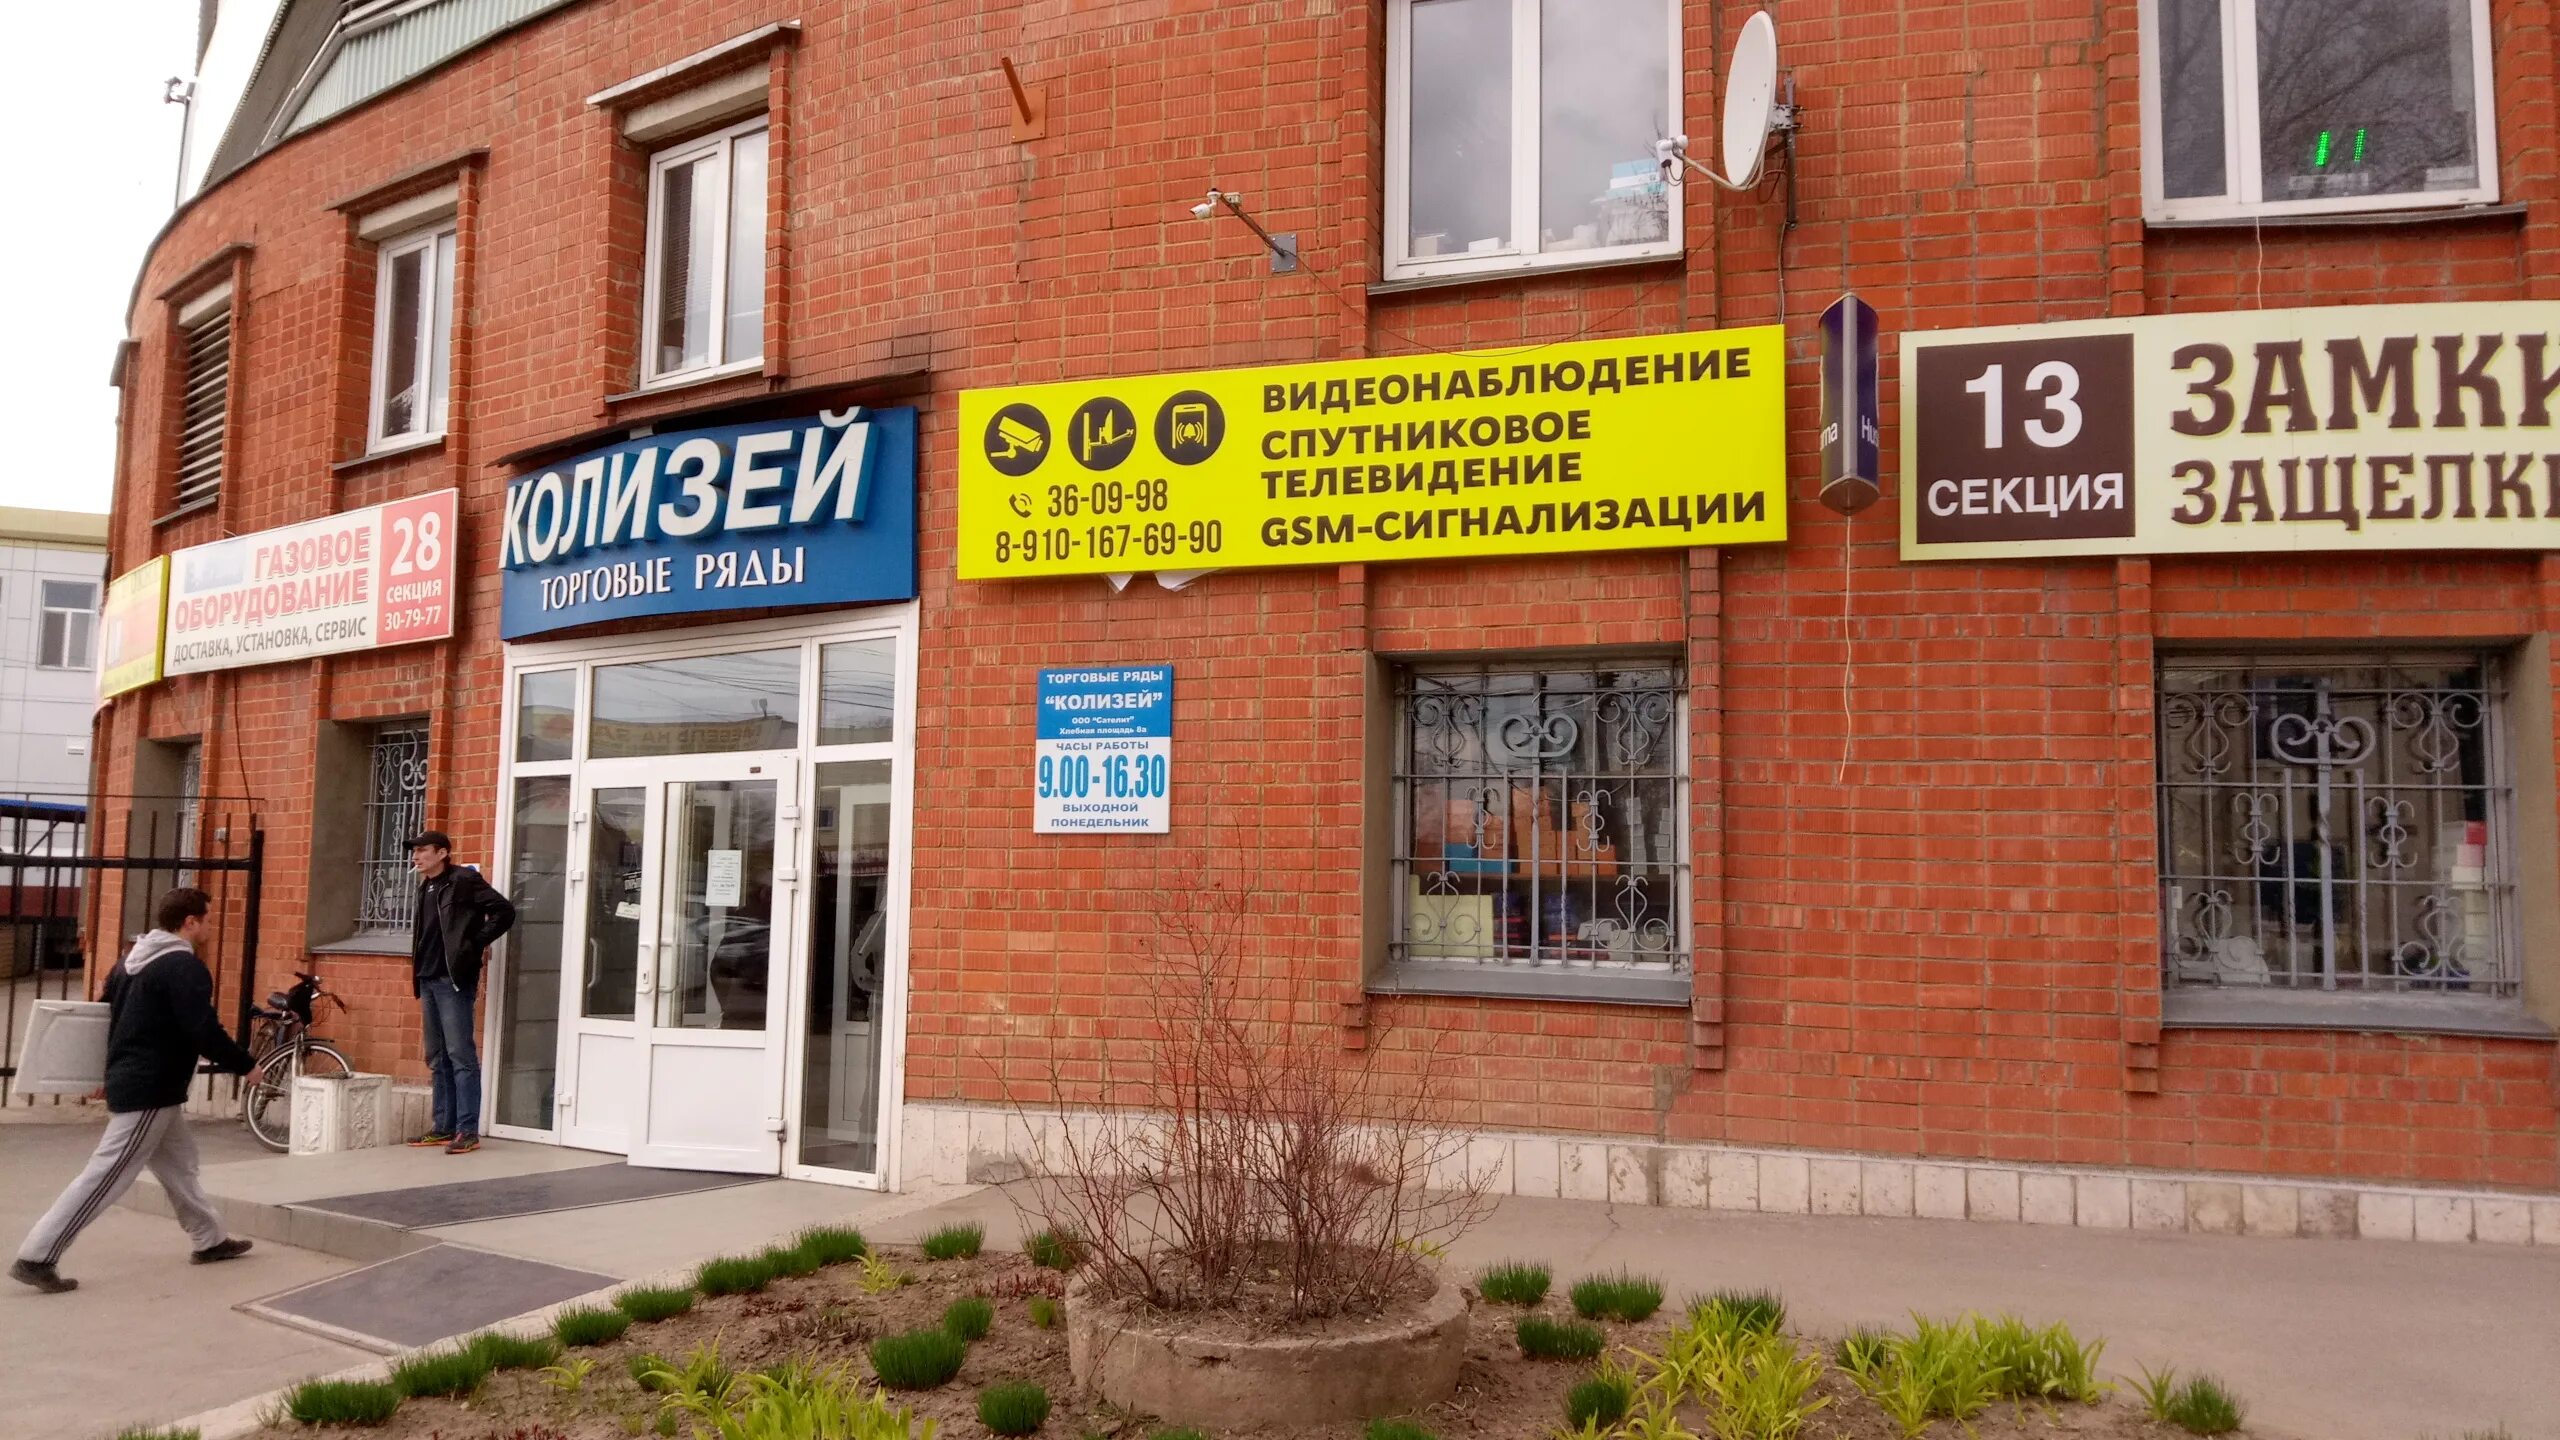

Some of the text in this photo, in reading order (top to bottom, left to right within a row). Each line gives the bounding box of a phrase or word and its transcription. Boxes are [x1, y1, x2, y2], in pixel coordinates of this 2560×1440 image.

[1262, 347, 1752, 414] ВИДЕОНАБЛЮДЕНИЕ
[1965, 360, 2083, 450] 13
[1261, 409, 1592, 461] СПУТНИКОВОЕ
[499, 406, 876, 569] КОЛИЗЕЙ
[1048, 478, 1168, 517] 36-09-98
[1261, 452, 1582, 499] ТЕЛЕВИДЕНИЕ
[1928, 473, 2124, 519] СЕКЦИЯ
[996, 519, 1222, 563] 8-910-167-69-90
[1261, 491, 1766, 548] GSM-СИГНАЛИЗАЦИИ
[254, 526, 370, 579] ГАЗОВОЕ
[389, 511, 441, 577] 28
[175, 569, 368, 632] ОБОРУДОВАНИЕ
[386, 578, 442, 603] секция
[541, 546, 805, 611] ТОРГОВЫЕ РЯДЫ
[173, 616, 367, 666] ДОСТАВКА, УСТАНОВКА, СЕРВИС
[385, 605, 441, 632] 30-79-77
[1047, 670, 1163, 684] ТОРГОВЫЕ РЯДЫ
[1056, 741, 1149, 751] ЧАСЫ РАБОТЫ
[1097, 726, 1134, 734] площадь
[1051, 818, 1149, 829] ПОНЕДЕЛЬНИК
[1062, 802, 1138, 813] ВЫХОДНОЙ
